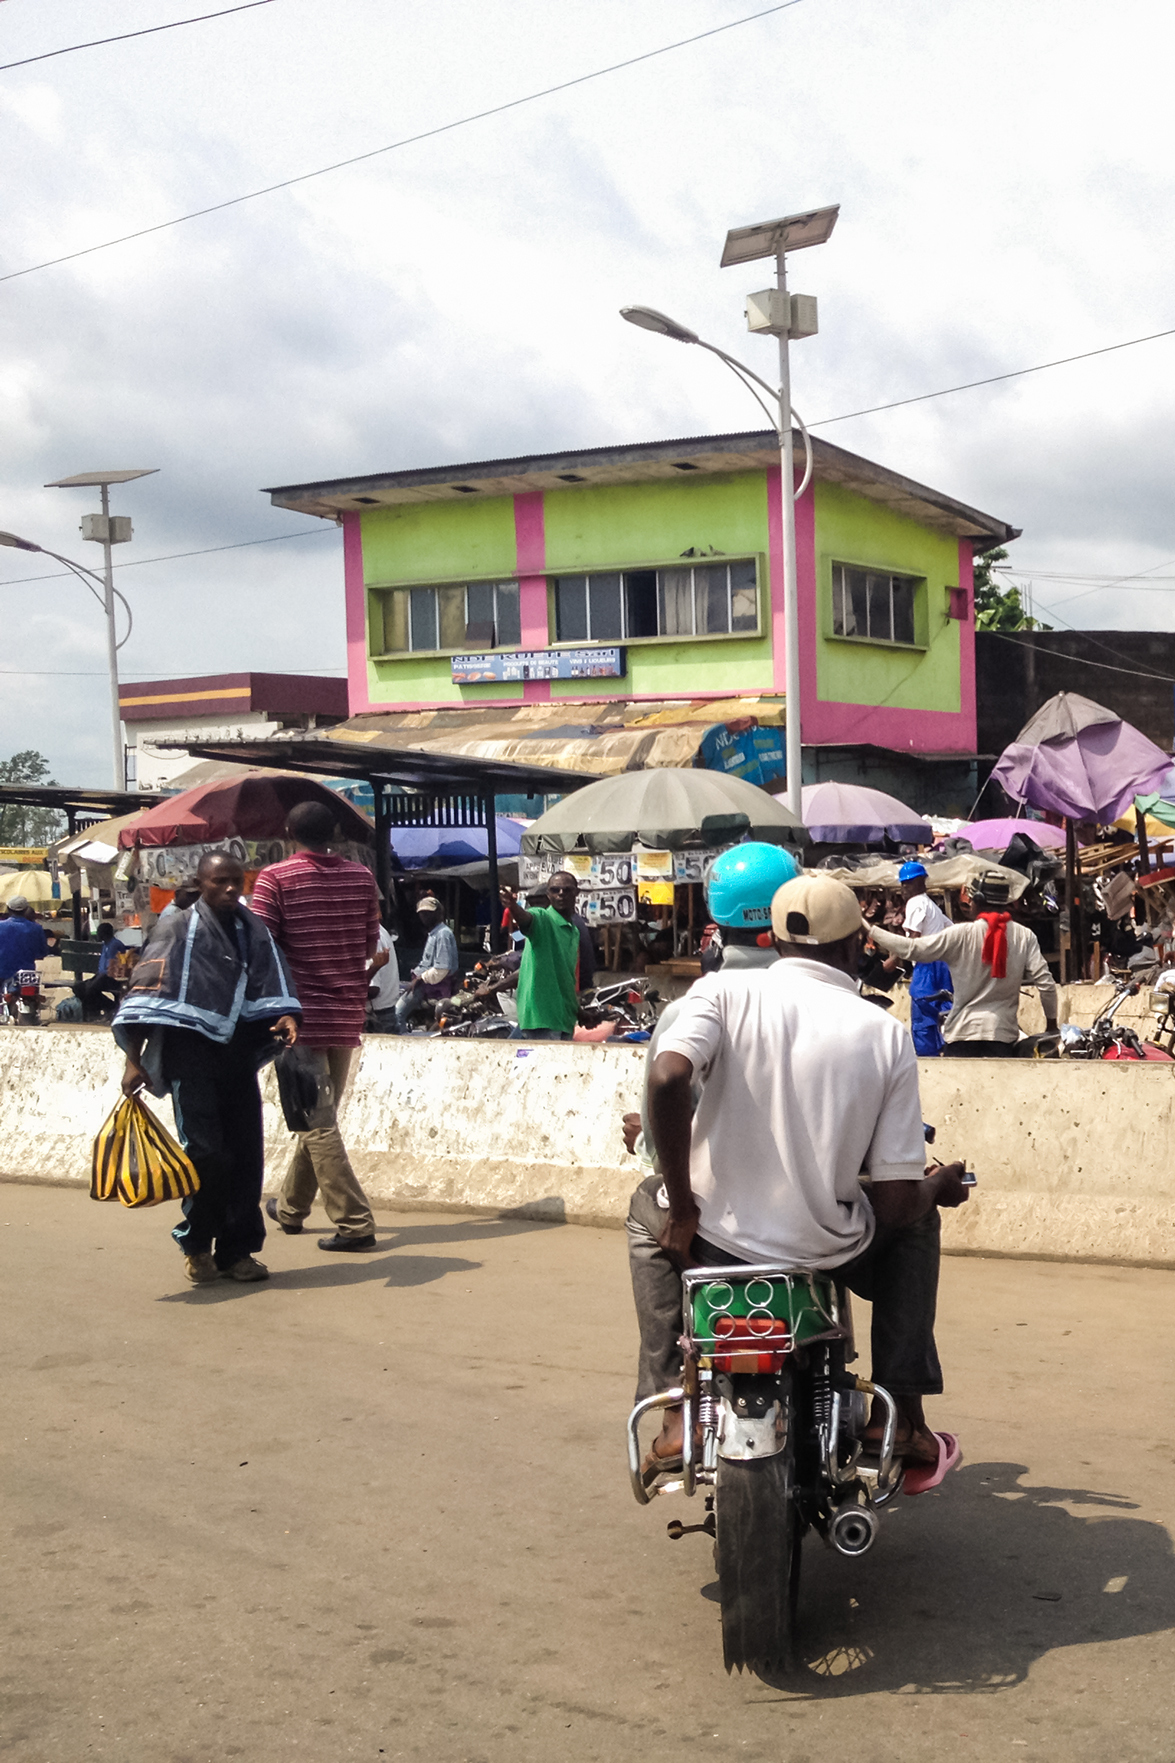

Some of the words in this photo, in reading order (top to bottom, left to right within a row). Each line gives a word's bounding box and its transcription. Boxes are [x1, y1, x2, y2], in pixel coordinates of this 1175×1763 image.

[601, 861, 632, 885] 50
[600, 894, 635, 920] 50
[743, 908, 760, 921] MOTO
